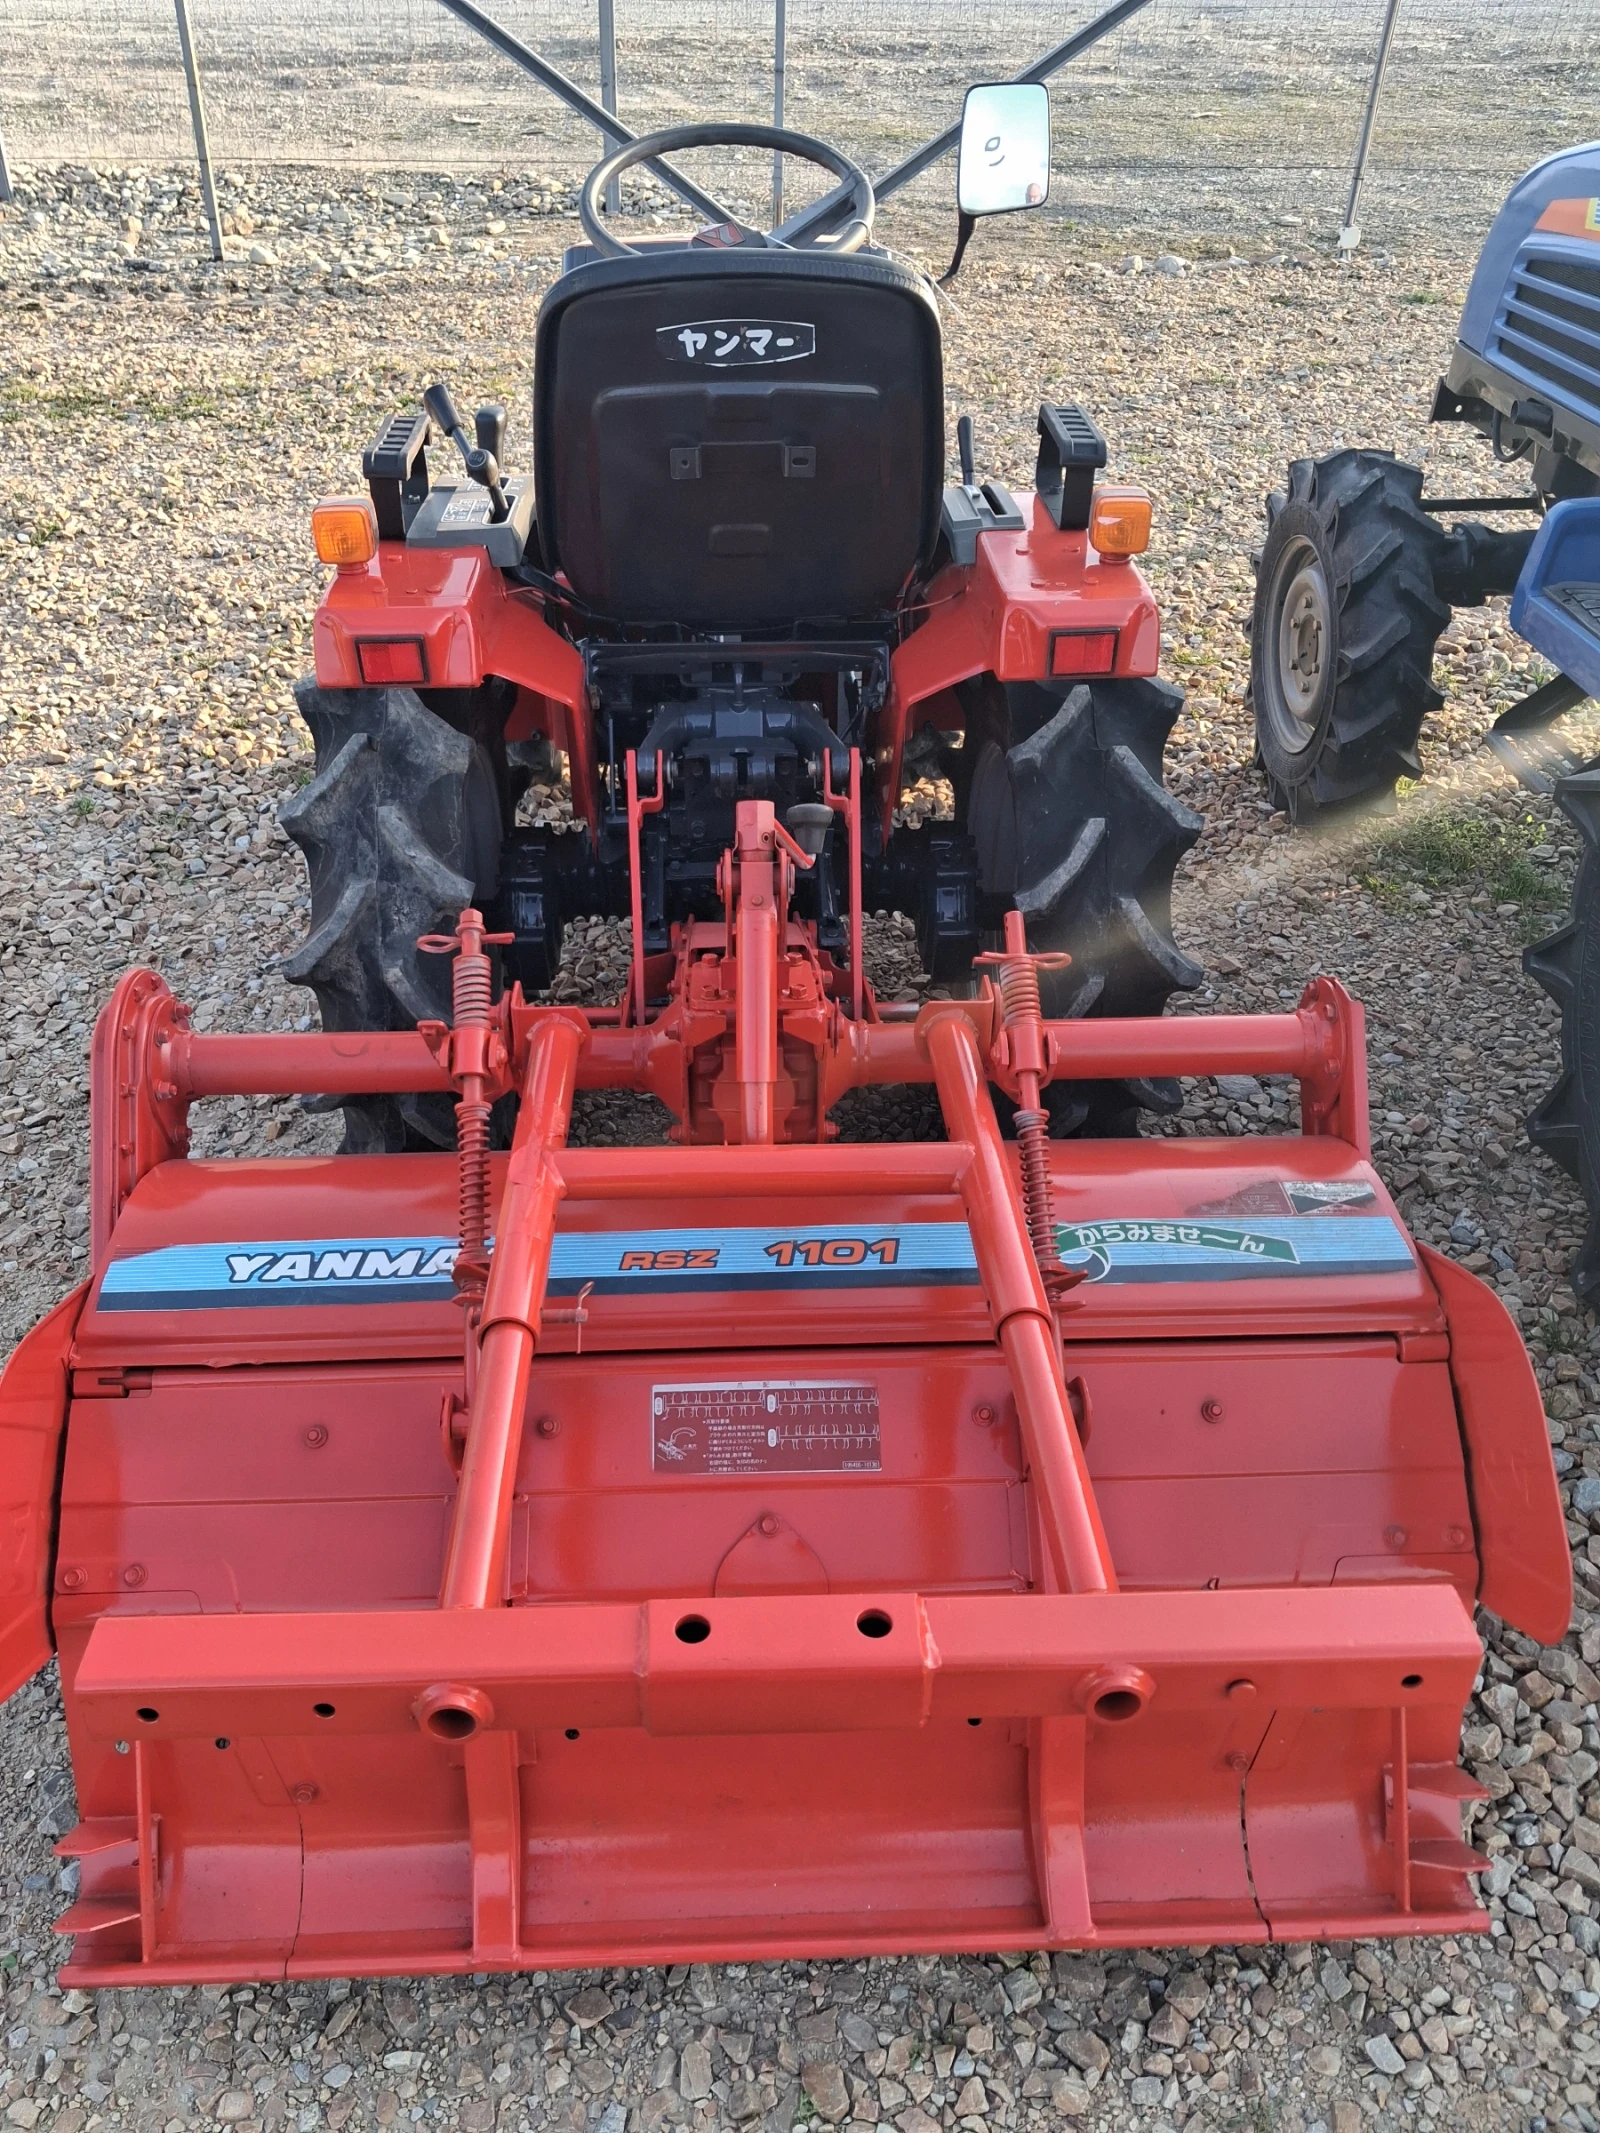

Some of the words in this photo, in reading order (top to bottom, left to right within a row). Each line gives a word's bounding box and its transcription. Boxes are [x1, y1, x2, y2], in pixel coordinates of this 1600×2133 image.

[678, 328, 794, 358] ヤンマー
[226, 1246, 494, 1283] YANMA
[618, 1249, 720, 1271] RSZ
[763, 1238, 900, 1267] 1101
